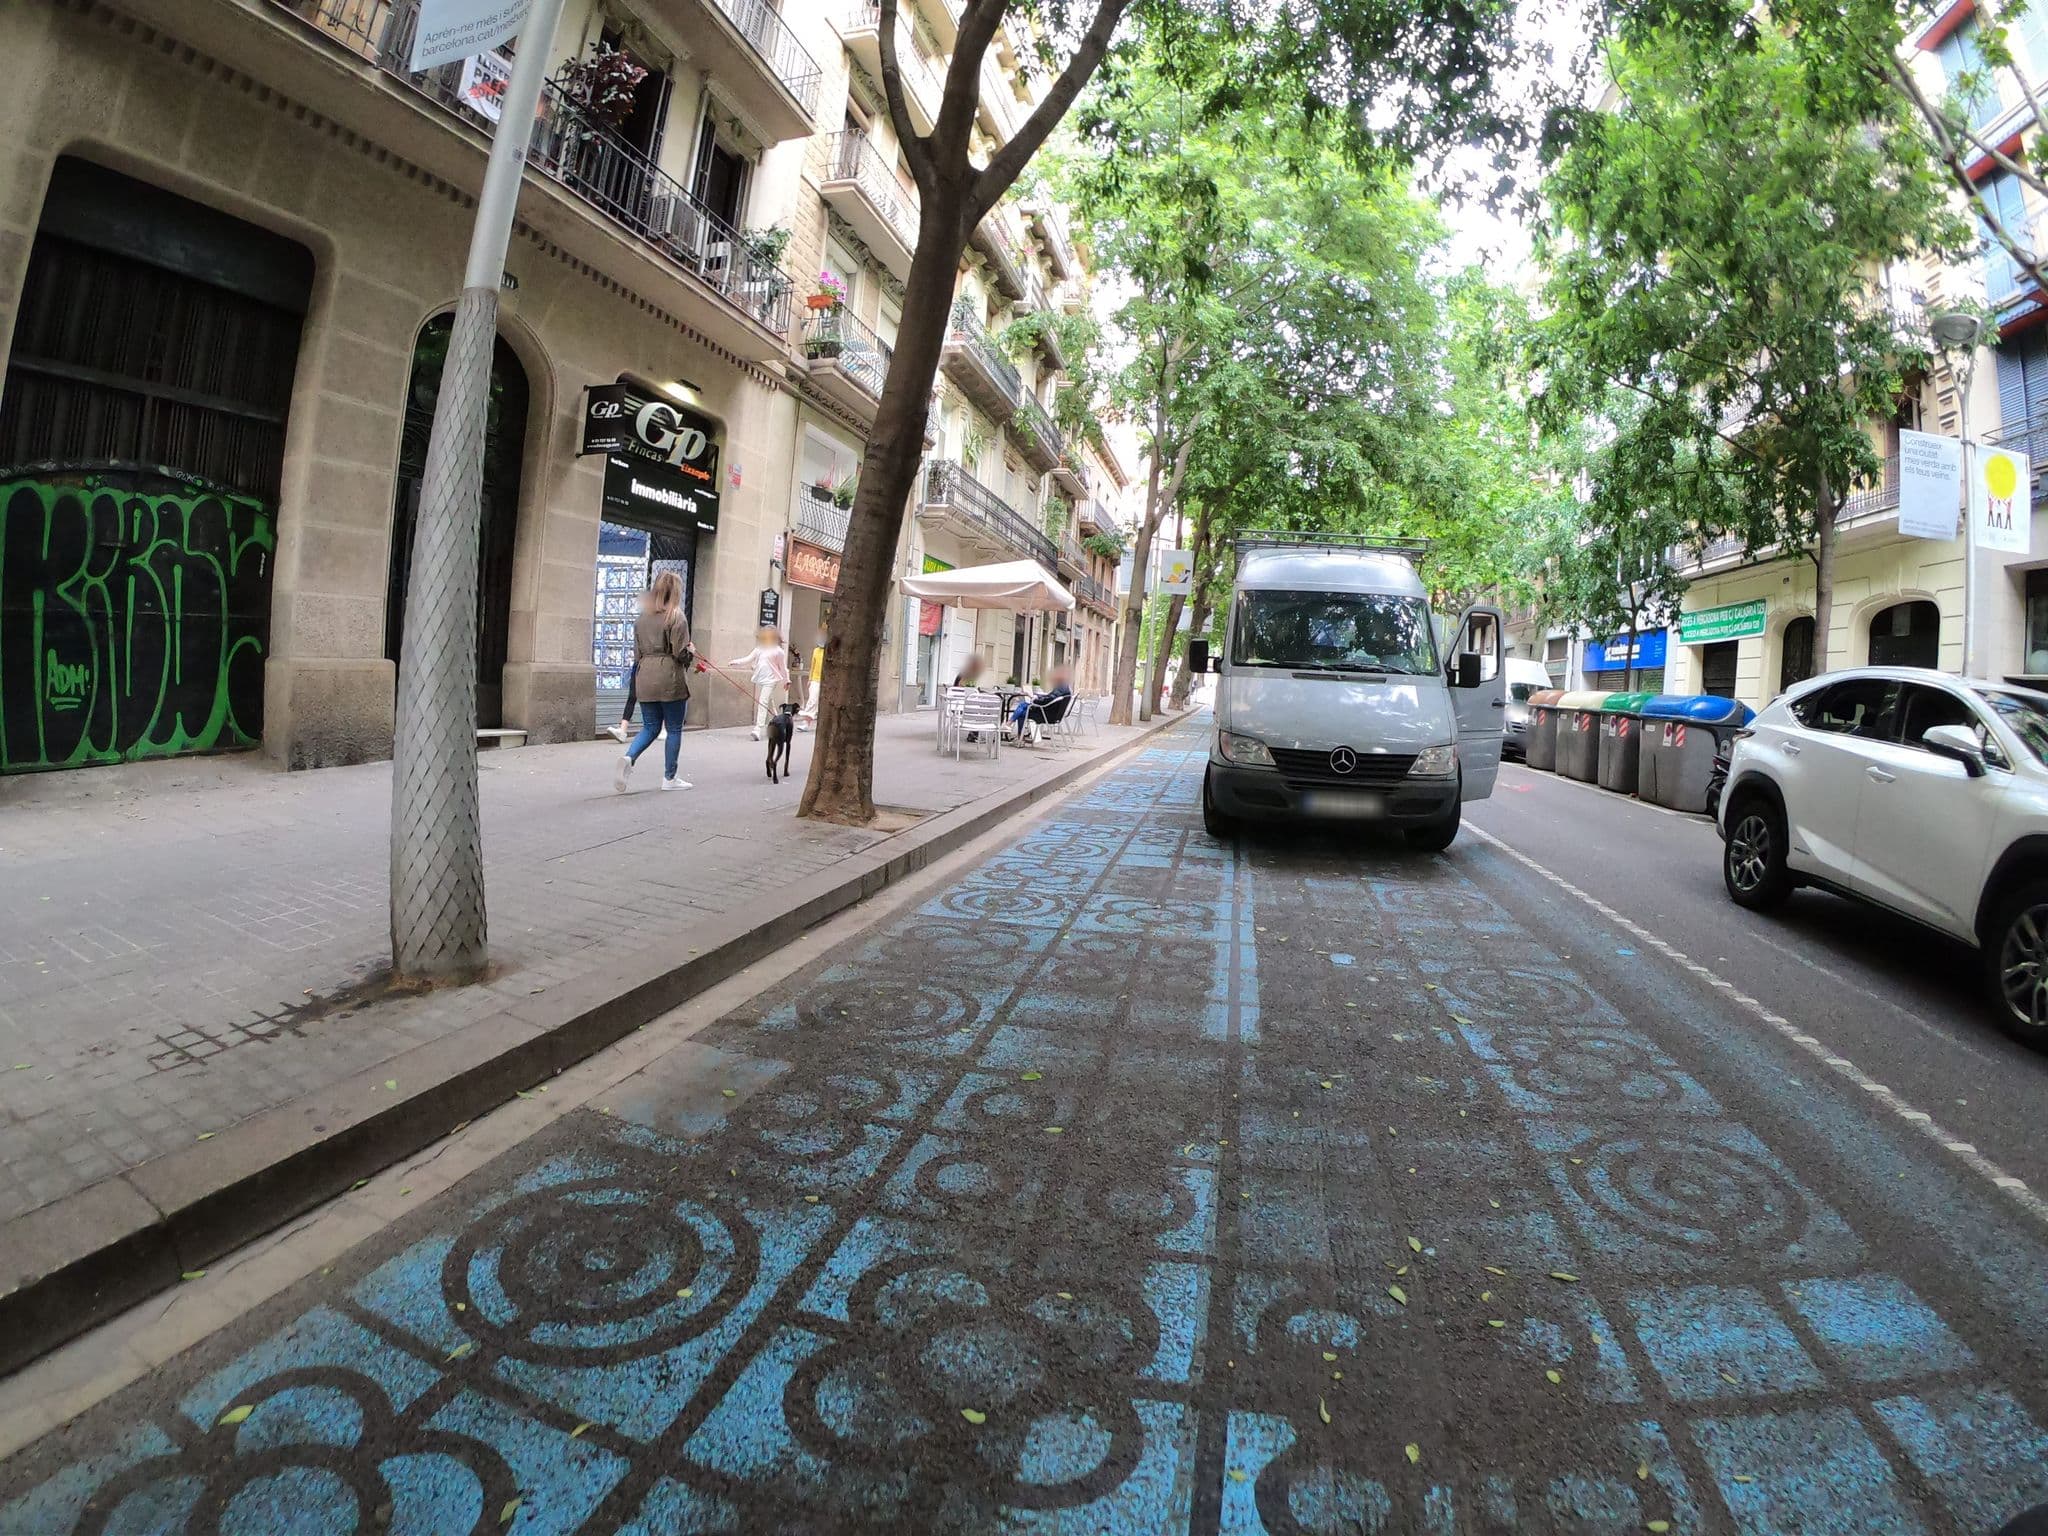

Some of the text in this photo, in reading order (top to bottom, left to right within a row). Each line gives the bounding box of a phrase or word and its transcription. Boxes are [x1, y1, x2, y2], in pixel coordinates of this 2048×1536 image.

[477, 53, 511, 80] LLIBER
[636, 401, 707, 466] Gp
[628, 438, 664, 463] Fincas
